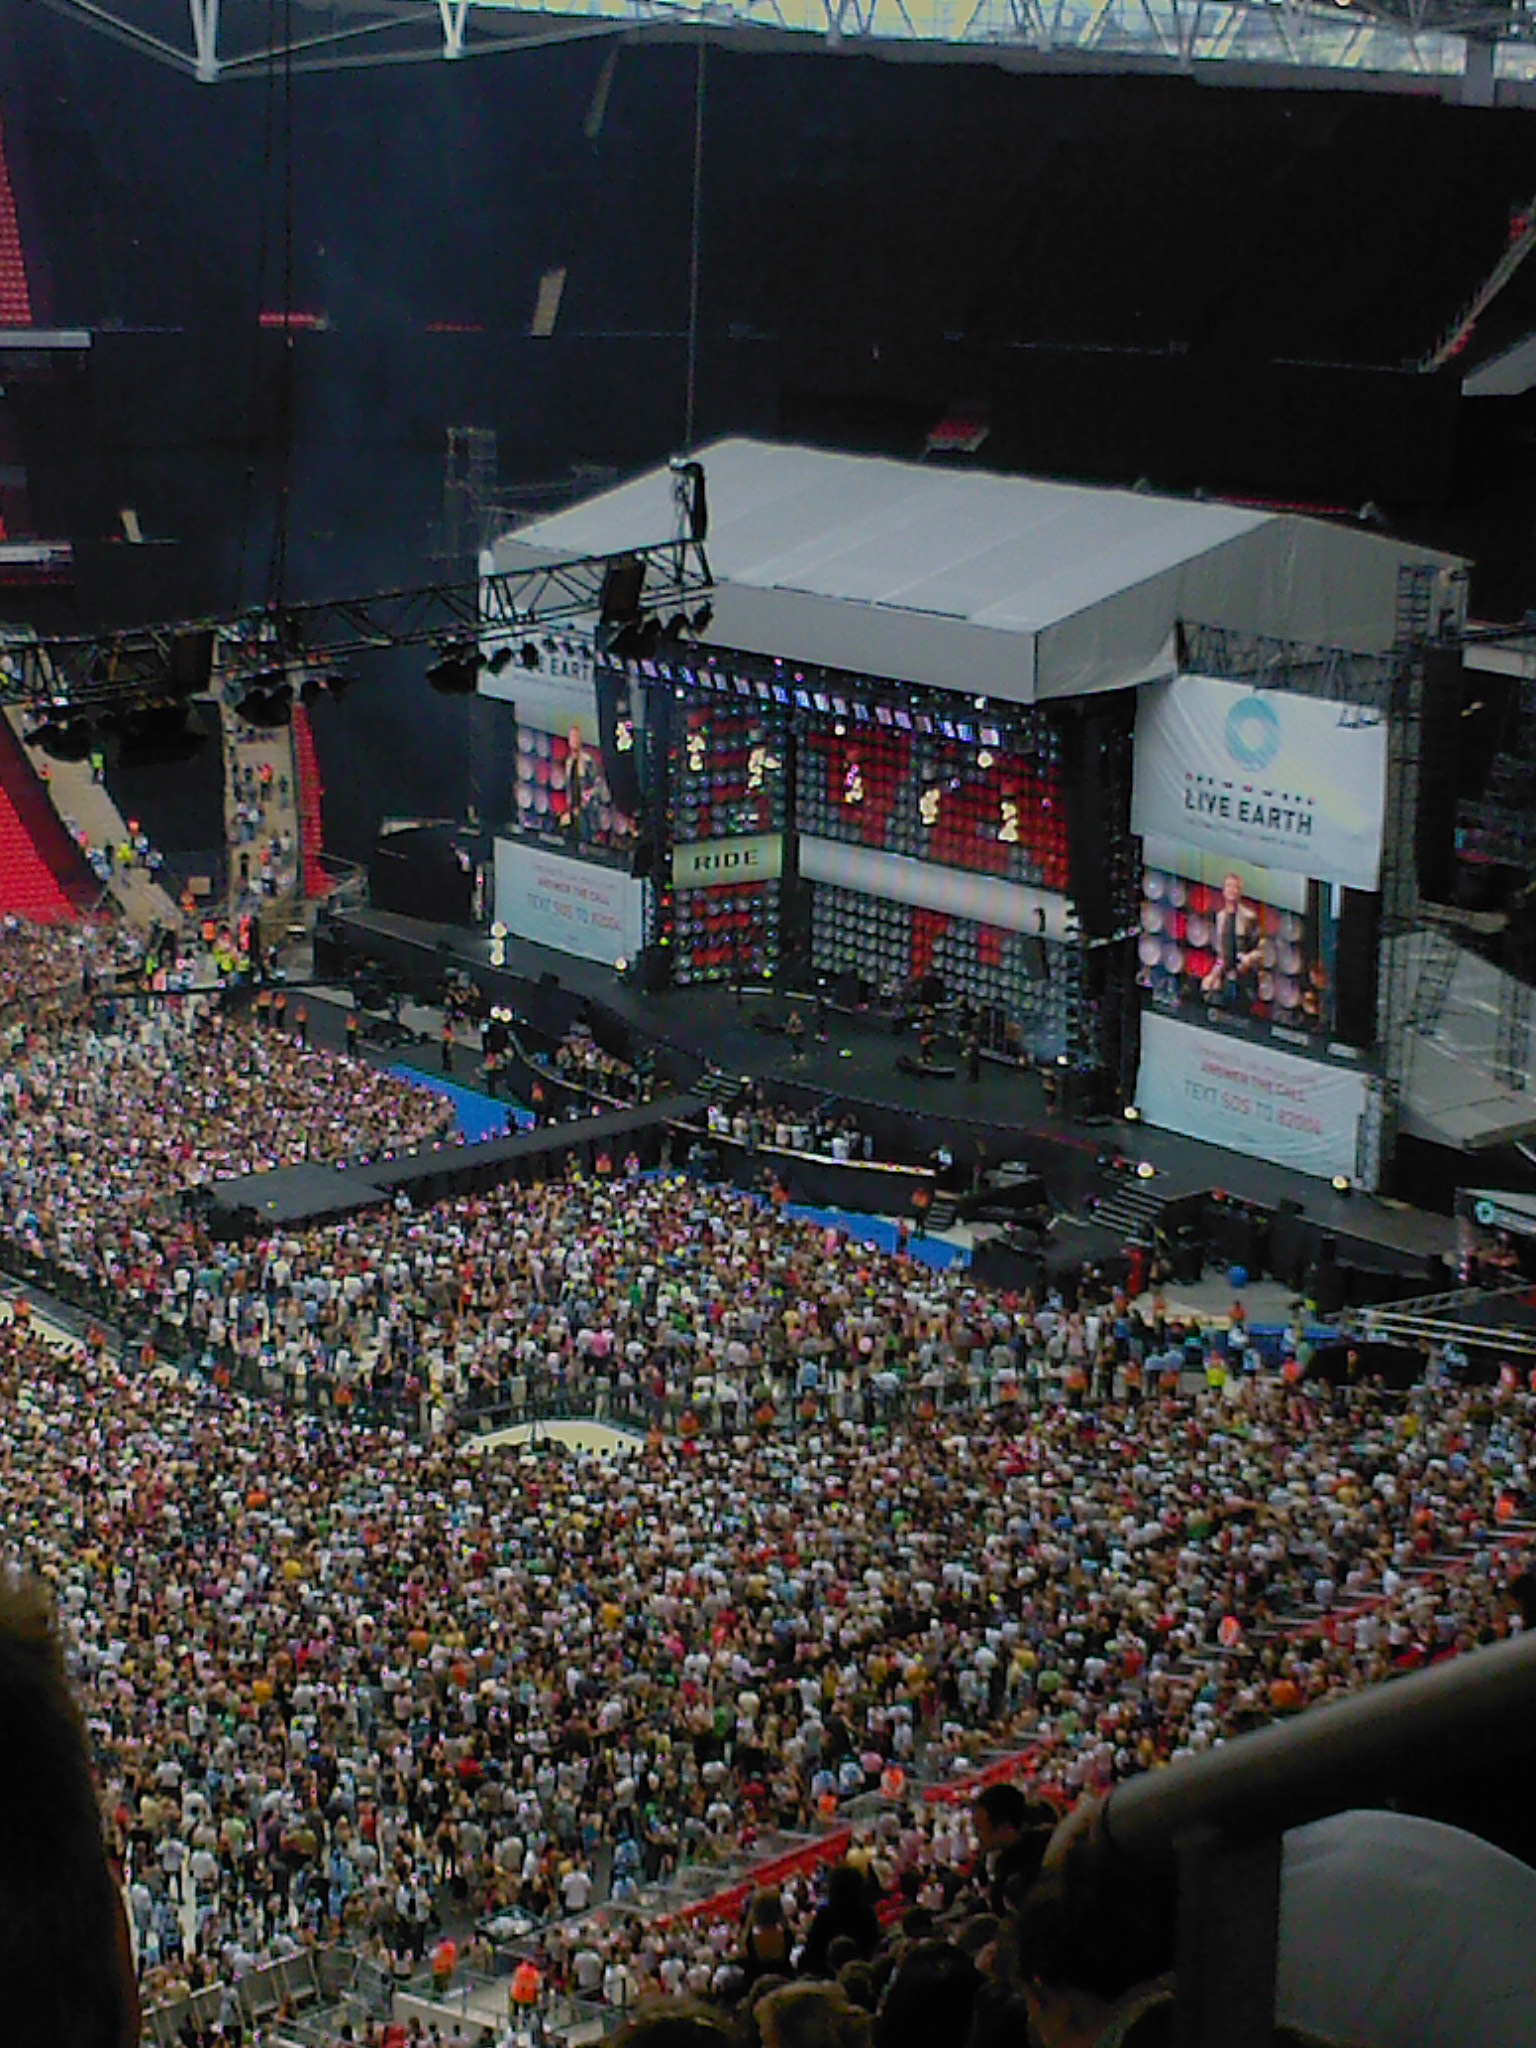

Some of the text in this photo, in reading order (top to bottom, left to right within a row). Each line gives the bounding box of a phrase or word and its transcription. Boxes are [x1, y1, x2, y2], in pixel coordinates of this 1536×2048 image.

[550, 655, 591, 682] EART
[1185, 788, 1230, 818] LIVE
[1238, 800, 1312, 836] EARTH
[694, 849, 759, 870] RIDE
